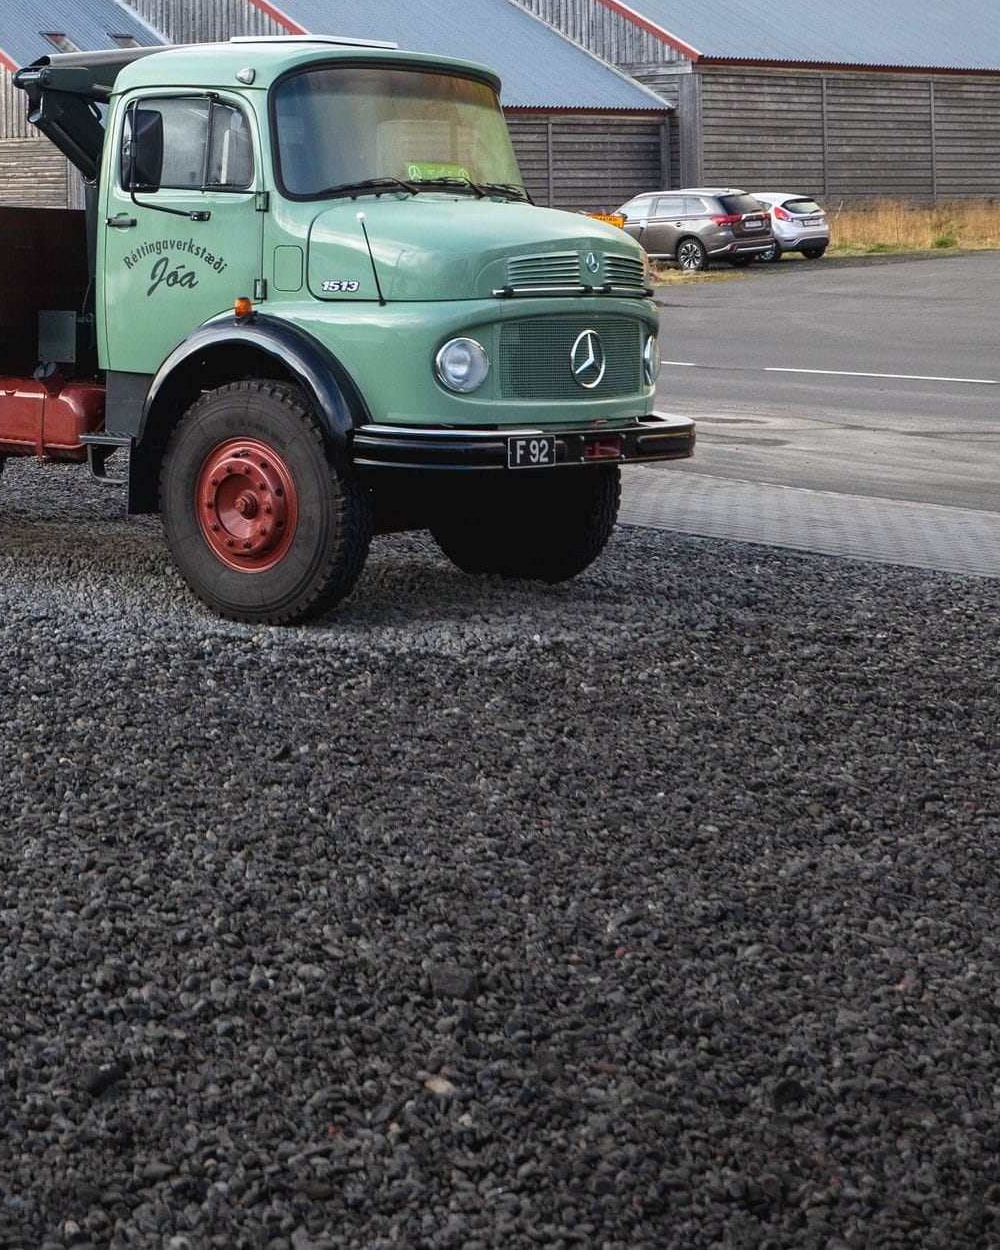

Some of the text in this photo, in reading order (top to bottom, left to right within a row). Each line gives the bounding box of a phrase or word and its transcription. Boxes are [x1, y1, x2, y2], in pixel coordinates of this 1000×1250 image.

[123, 237, 228, 274] Réttingaverkstæði
[147, 256, 199, 297] Jóa
[321, 280, 360, 292] 1513
